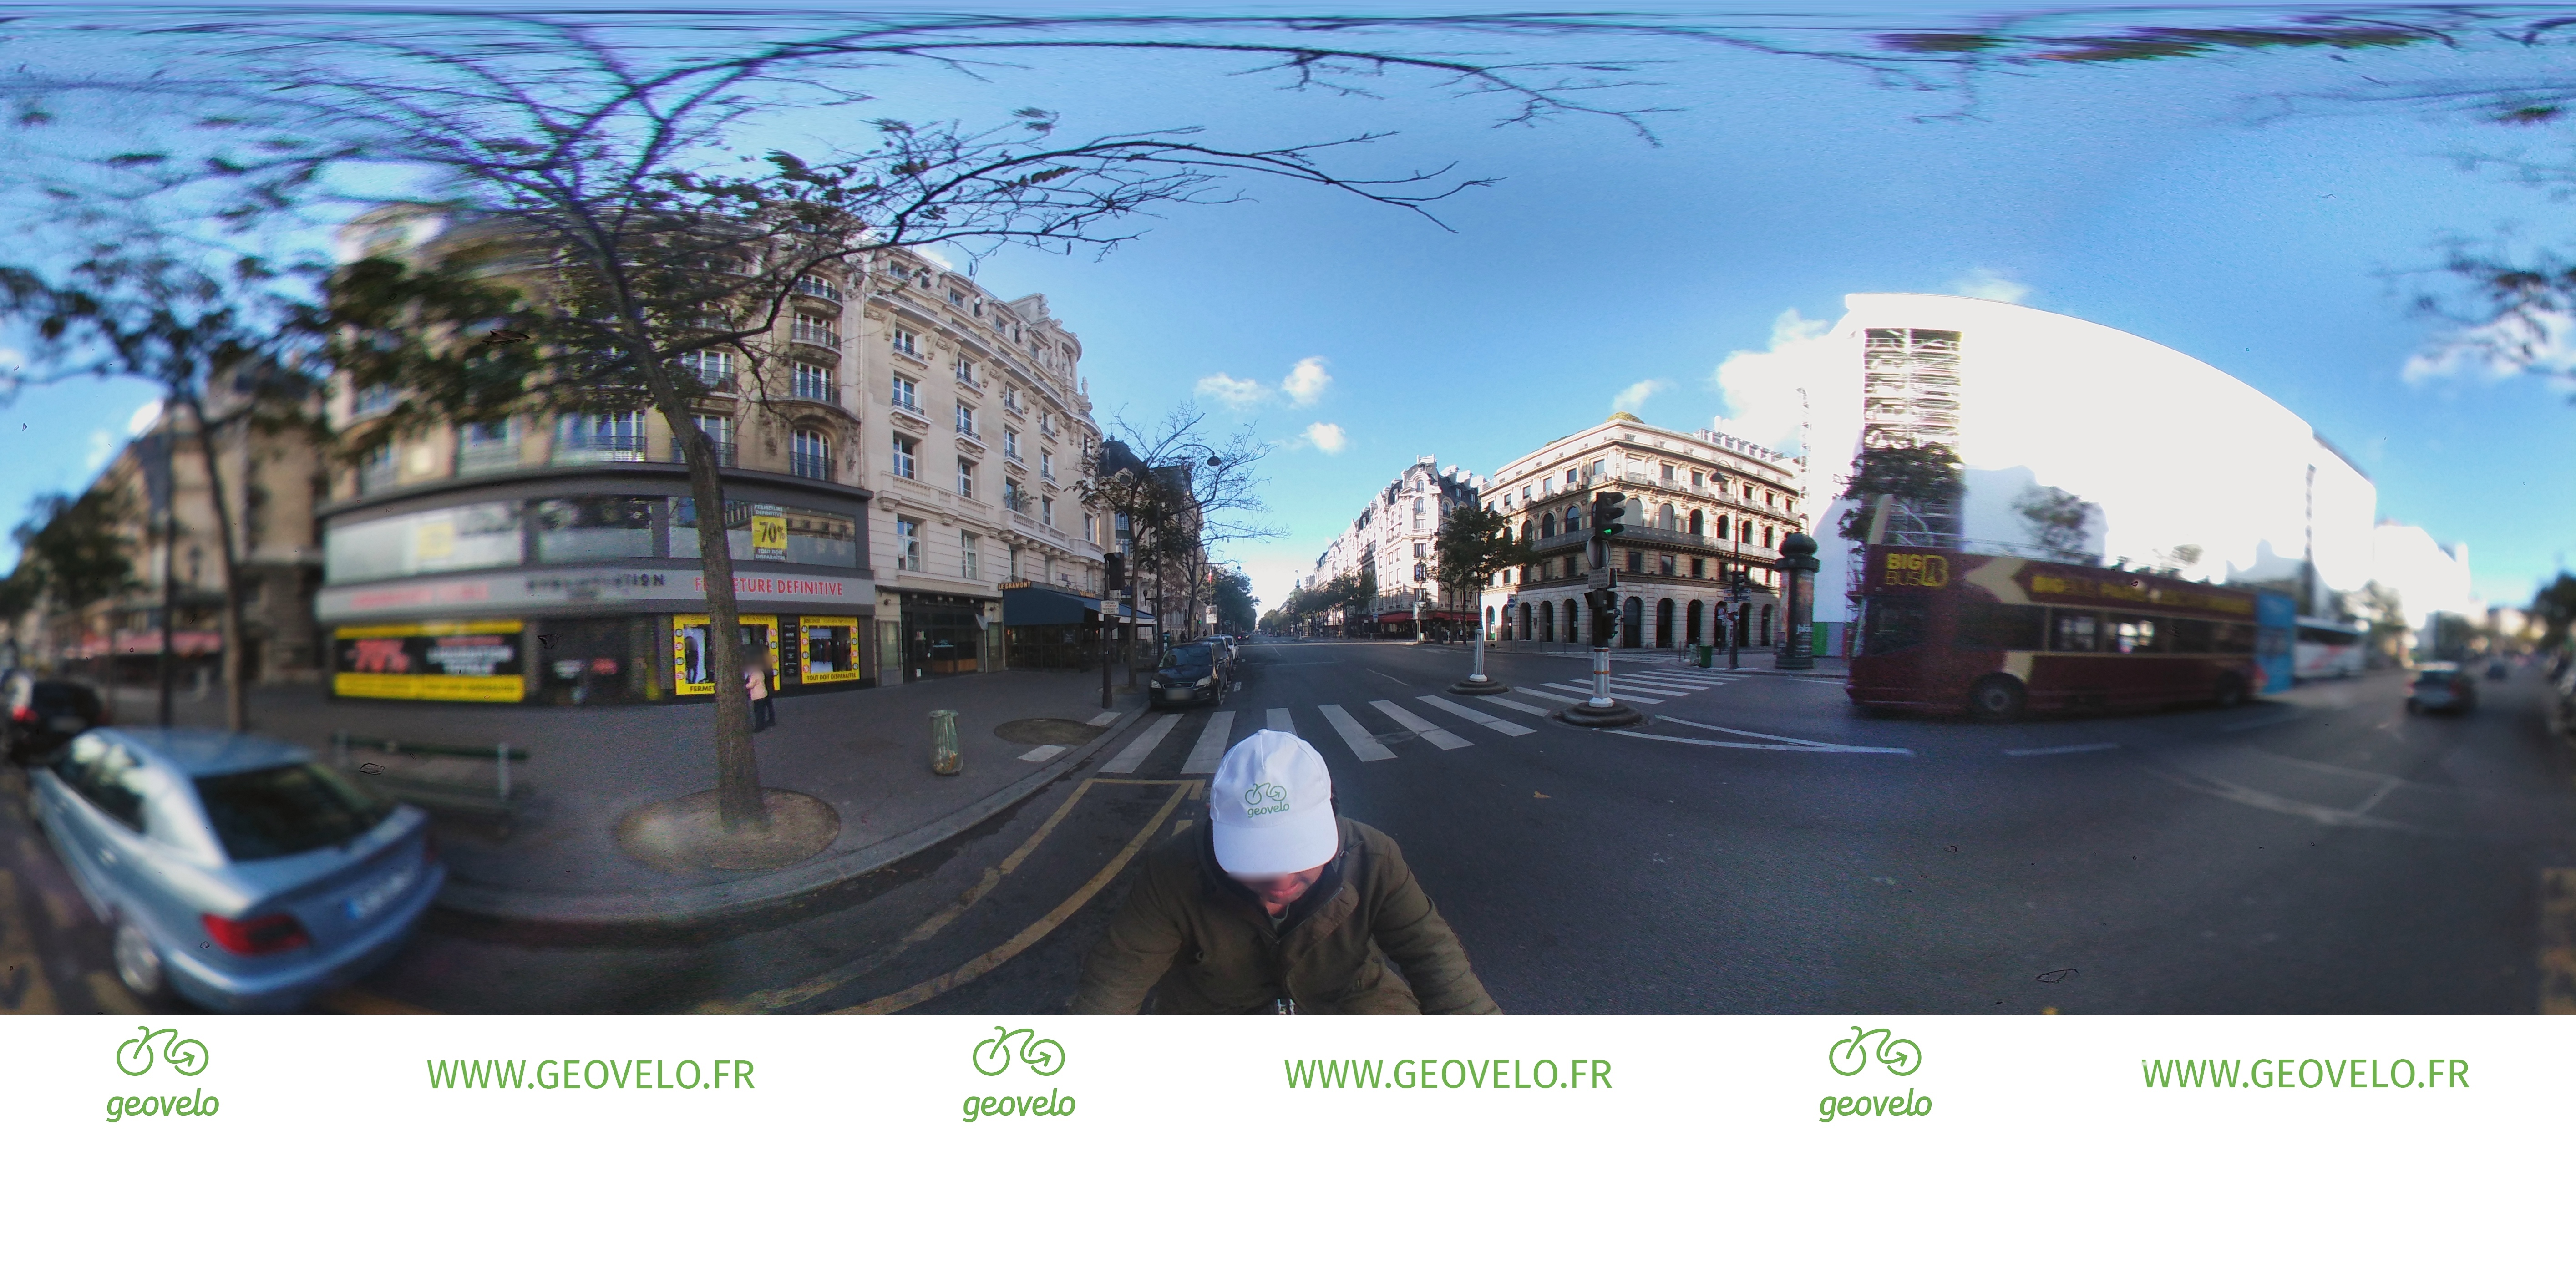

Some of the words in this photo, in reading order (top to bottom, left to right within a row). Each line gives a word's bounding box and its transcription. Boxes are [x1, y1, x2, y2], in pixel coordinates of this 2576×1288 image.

[1887, 553, 1922, 570] BIG
[777, 579, 842, 595] DEFINITIVE
[1005, 581, 1031, 589] GRAMONT
[1247, 801, 1290, 818] geovelo
